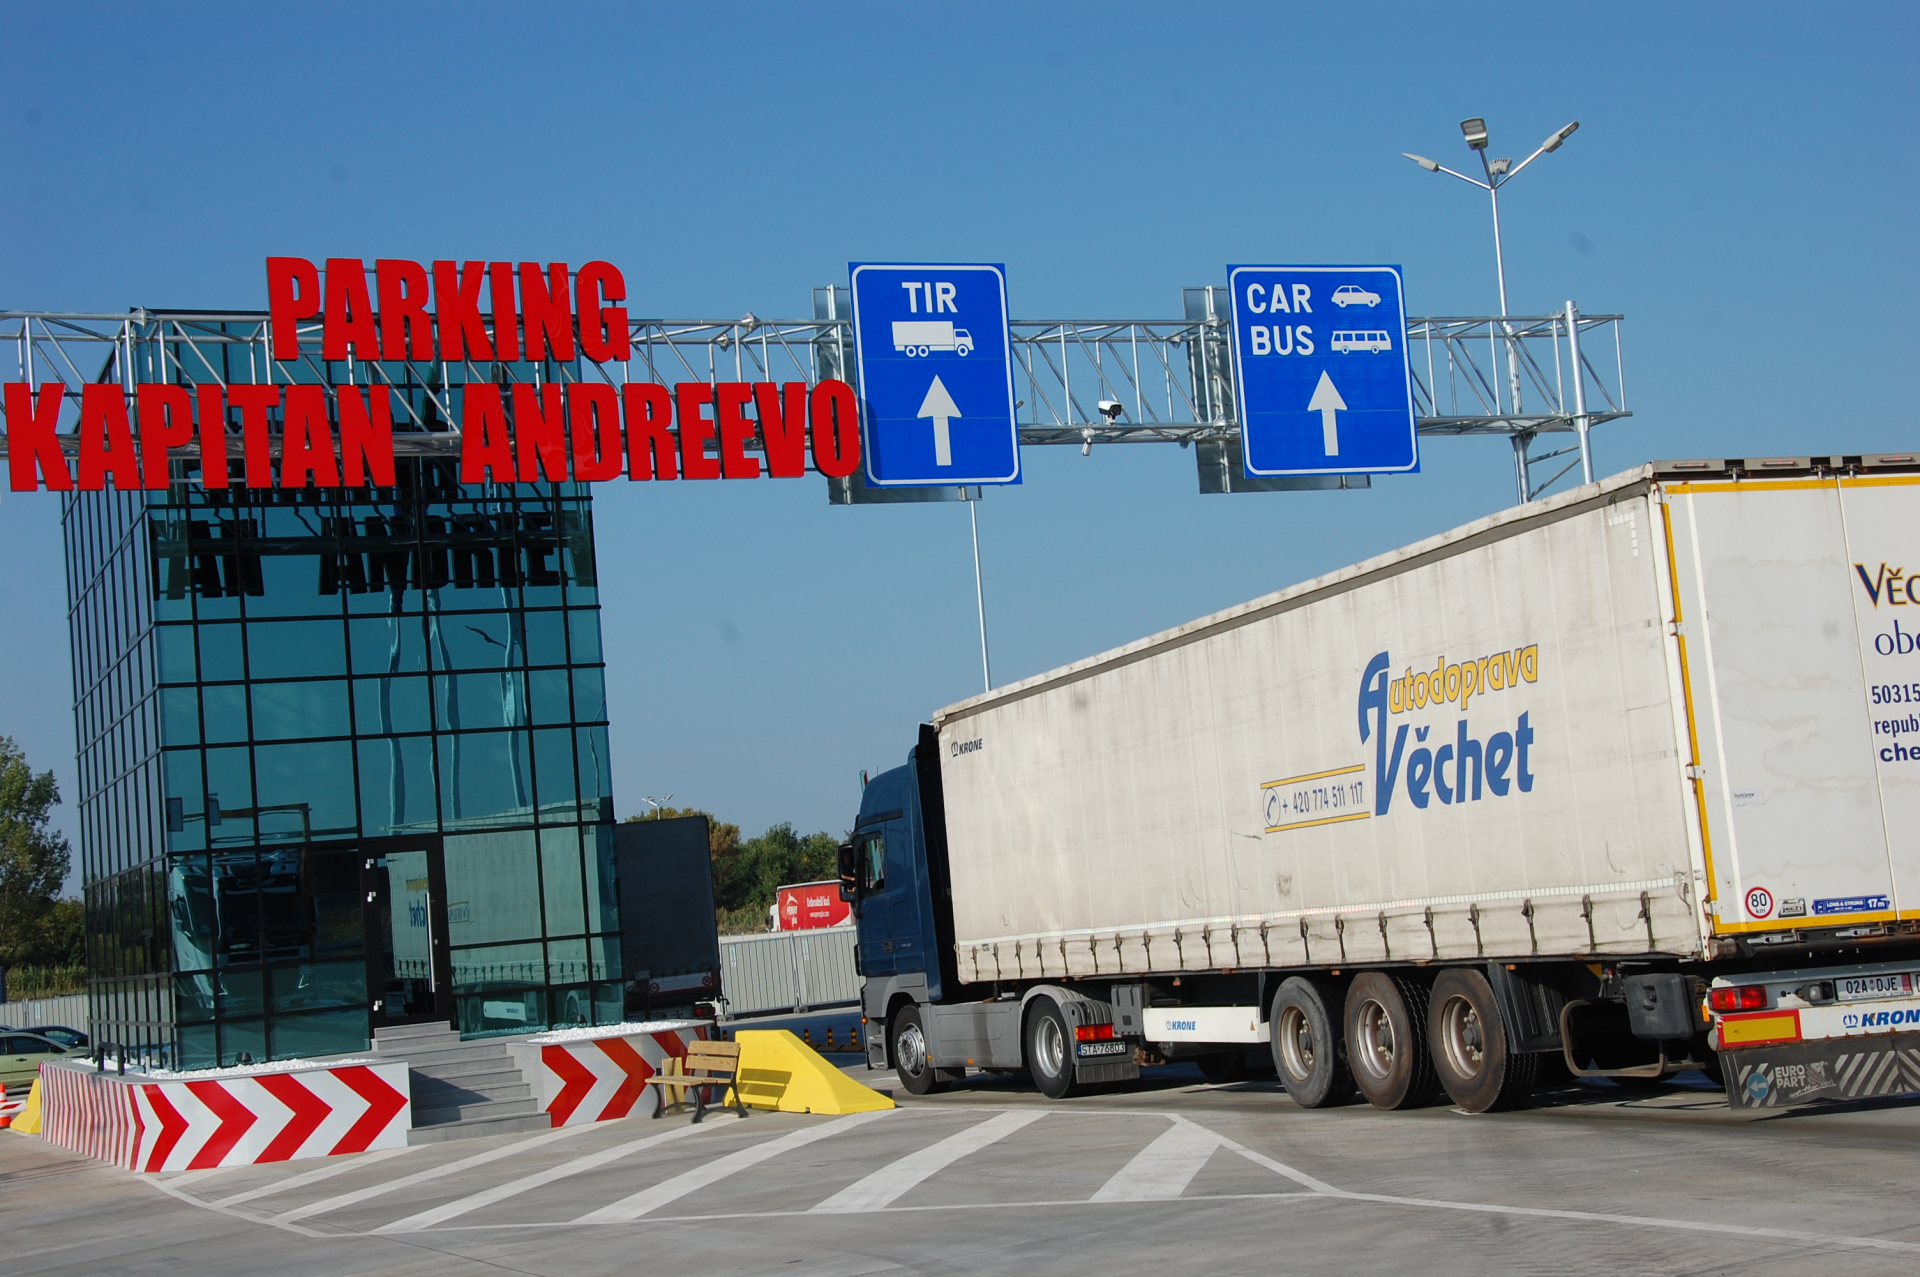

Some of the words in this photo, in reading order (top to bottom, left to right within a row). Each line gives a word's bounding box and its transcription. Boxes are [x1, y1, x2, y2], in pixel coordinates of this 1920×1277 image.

[267, 257, 631, 362] PARKING
[901, 282, 958, 313] TIR
[1247, 283, 1313, 314] CAR
[1250, 325, 1315, 356] BUS
[4, 383, 396, 491] KAPITAN
[461, 379, 861, 483] ANDREEVO
[1875, 619, 1920, 656] ob
[1358, 643, 1538, 746] Autodoprava
[1874, 713, 1920, 738] repub
[959, 738, 983, 755] KRONE
[1374, 708, 1534, 817] Věchet
[1293, 791, 1310, 814] 420
[1312, 787, 1329, 811] 774
[1332, 784, 1346, 808] 511
[1350, 781, 1364, 805] 117
[1750, 892, 1768, 908] 80
[1172, 1020, 1196, 1031] KRONE
[1774, 1064, 1806, 1078] EURO
[1776, 1075, 1806, 1088] PART
